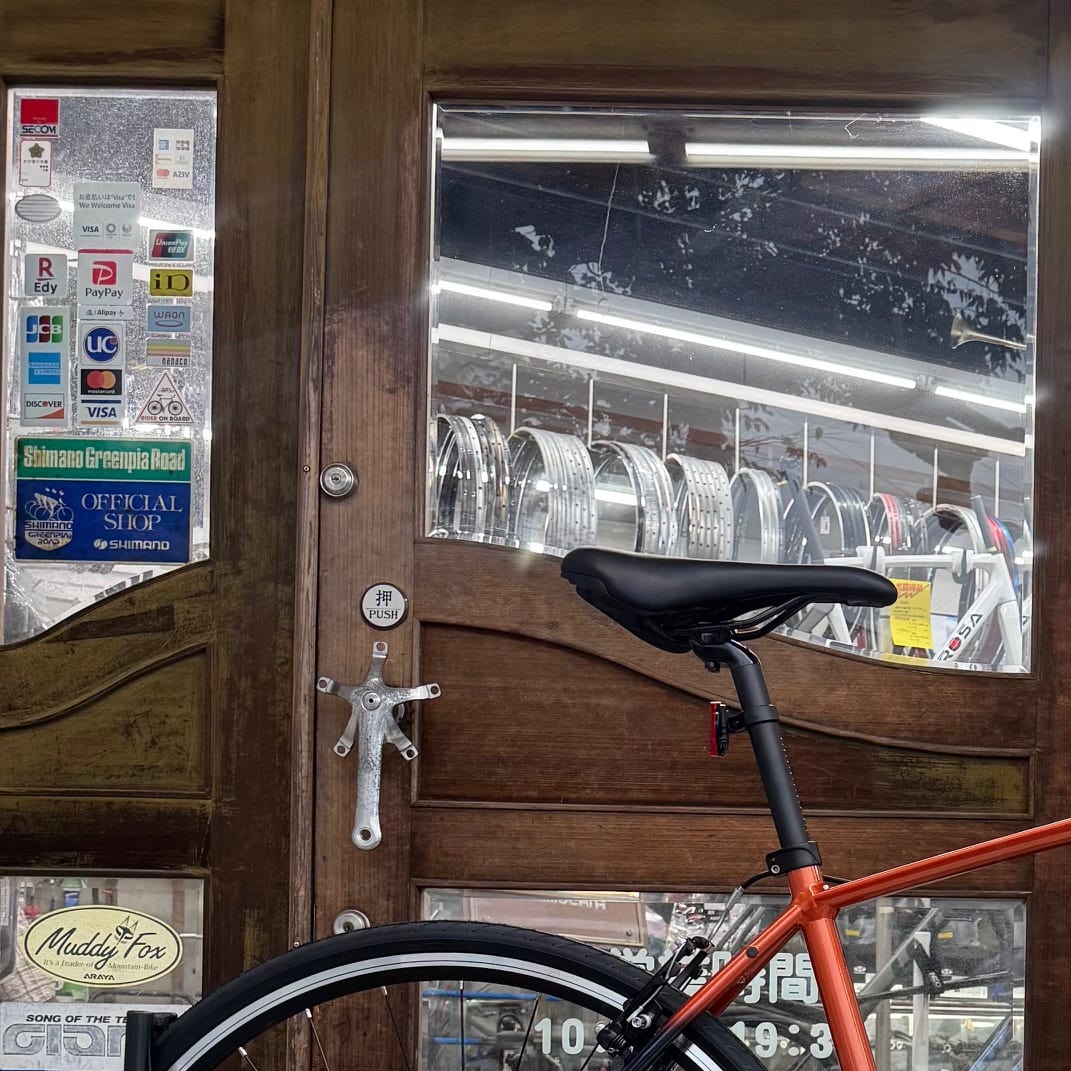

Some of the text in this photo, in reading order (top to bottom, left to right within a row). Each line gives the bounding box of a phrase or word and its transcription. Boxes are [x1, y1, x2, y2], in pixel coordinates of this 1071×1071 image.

[22, 125, 56, 134] SECOM
[156, 238, 188, 248] UnionPay
[153, 273, 190, 291] iD
[34, 282, 58, 295] Edy
[85, 287, 124, 299] PayPay
[153, 311, 185, 319] WAON
[27, 324, 62, 334] JCB
[87, 335, 117, 354] UC
[26, 400, 62, 408] DISCOVER
[86, 406, 117, 418] VISA
[24, 445, 186, 473] Shimano Greenpia Road
[81, 493, 183, 512] OFFICIAL
[25, 521, 72, 529] SHIMANO
[104, 513, 161, 531] SHOP
[109, 540, 170, 550] SHIMANO
[376, 590, 392, 606] 押
[369, 609, 398, 619] PUSH
[35, 927, 167, 970] Muddy Fox
[83, 973, 115, 981] ARAYA
[26, 1014, 61, 1023] SONG
[65, 1015, 82, 1023] OF
[86, 1015, 111, 1024] THE
